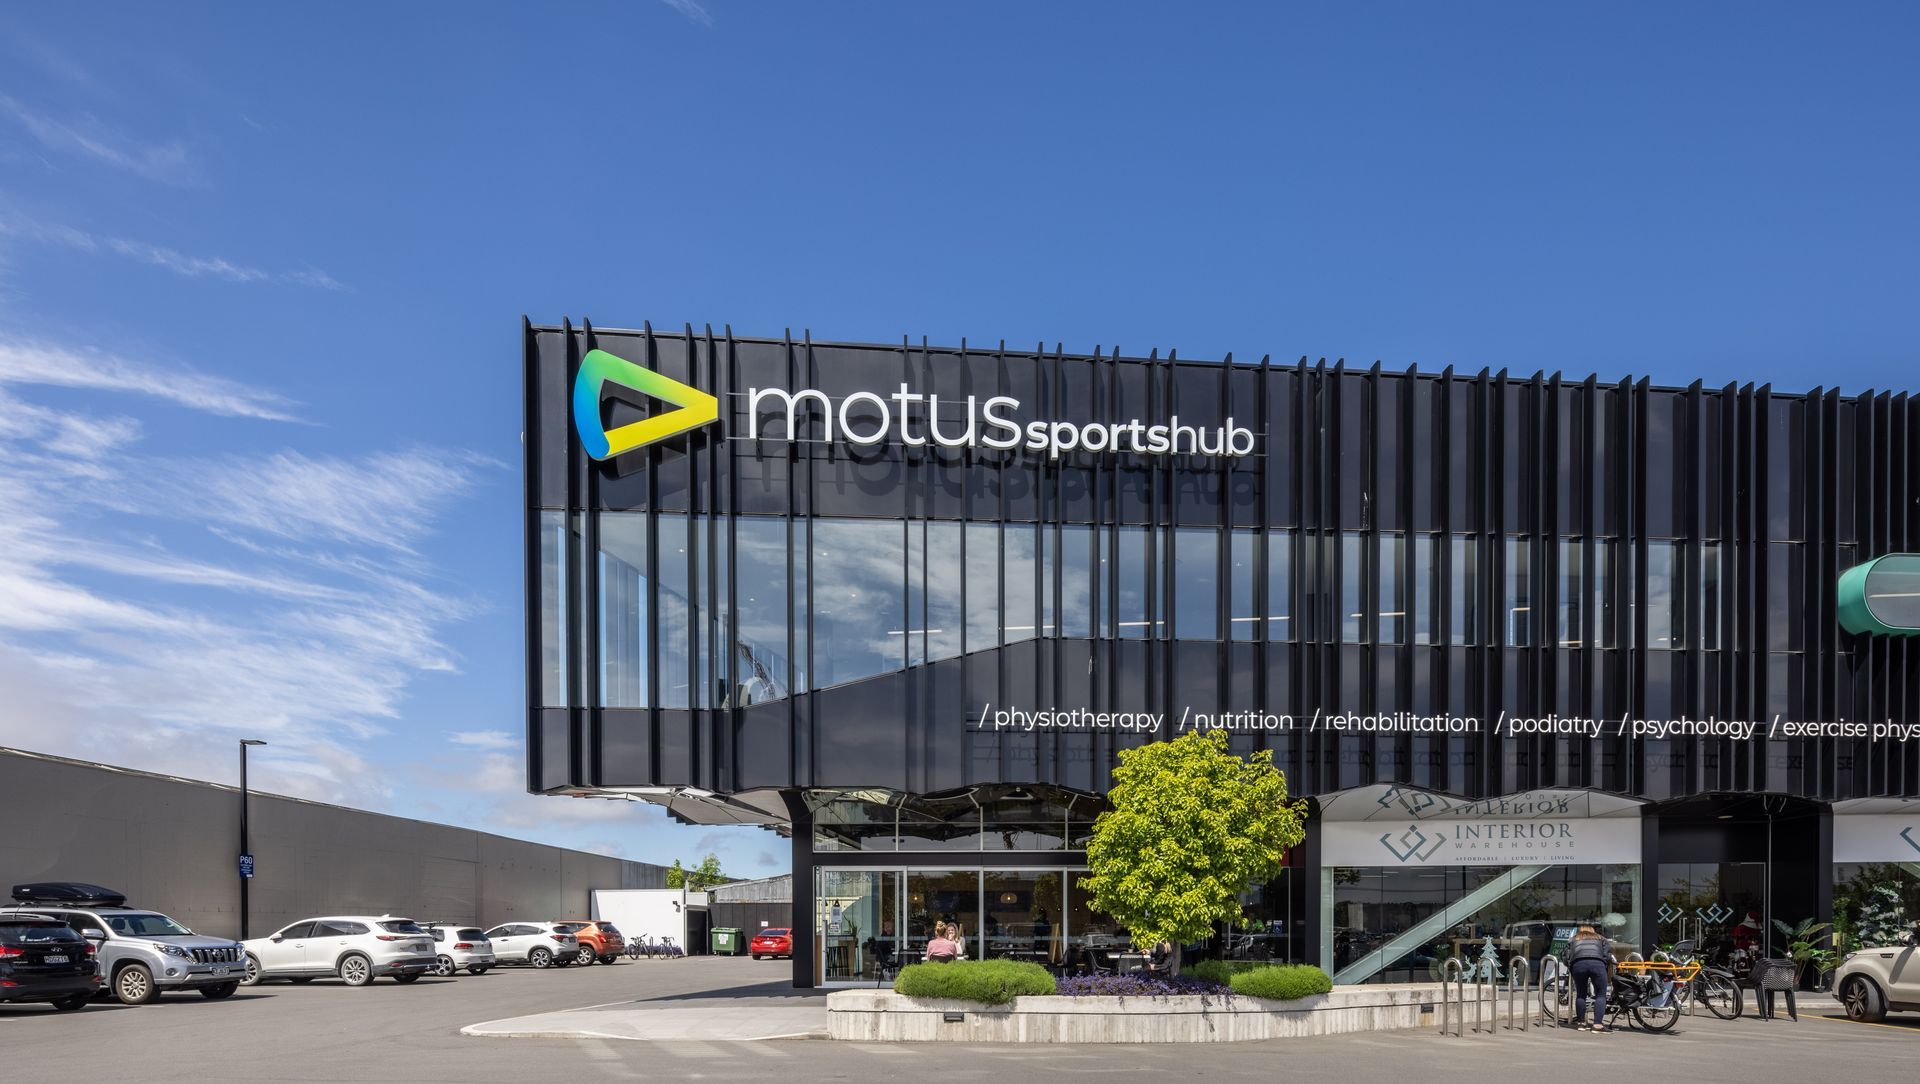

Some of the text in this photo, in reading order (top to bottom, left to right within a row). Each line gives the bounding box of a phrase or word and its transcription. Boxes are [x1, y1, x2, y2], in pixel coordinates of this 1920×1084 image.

[995, 706, 1164, 733] physiotherapy
[1194, 709, 1293, 730] nutrition
[1325, 711, 1479, 732] rehabilitation
[1509, 714, 1604, 738] podiatry
[1632, 716, 1756, 740] psychology
[1782, 718, 1868, 737] exercise
[1455, 823, 1574, 839] INTERIOR
[1455, 841, 1575, 849] WAREHOUSE
[240, 855, 253, 865] P60
